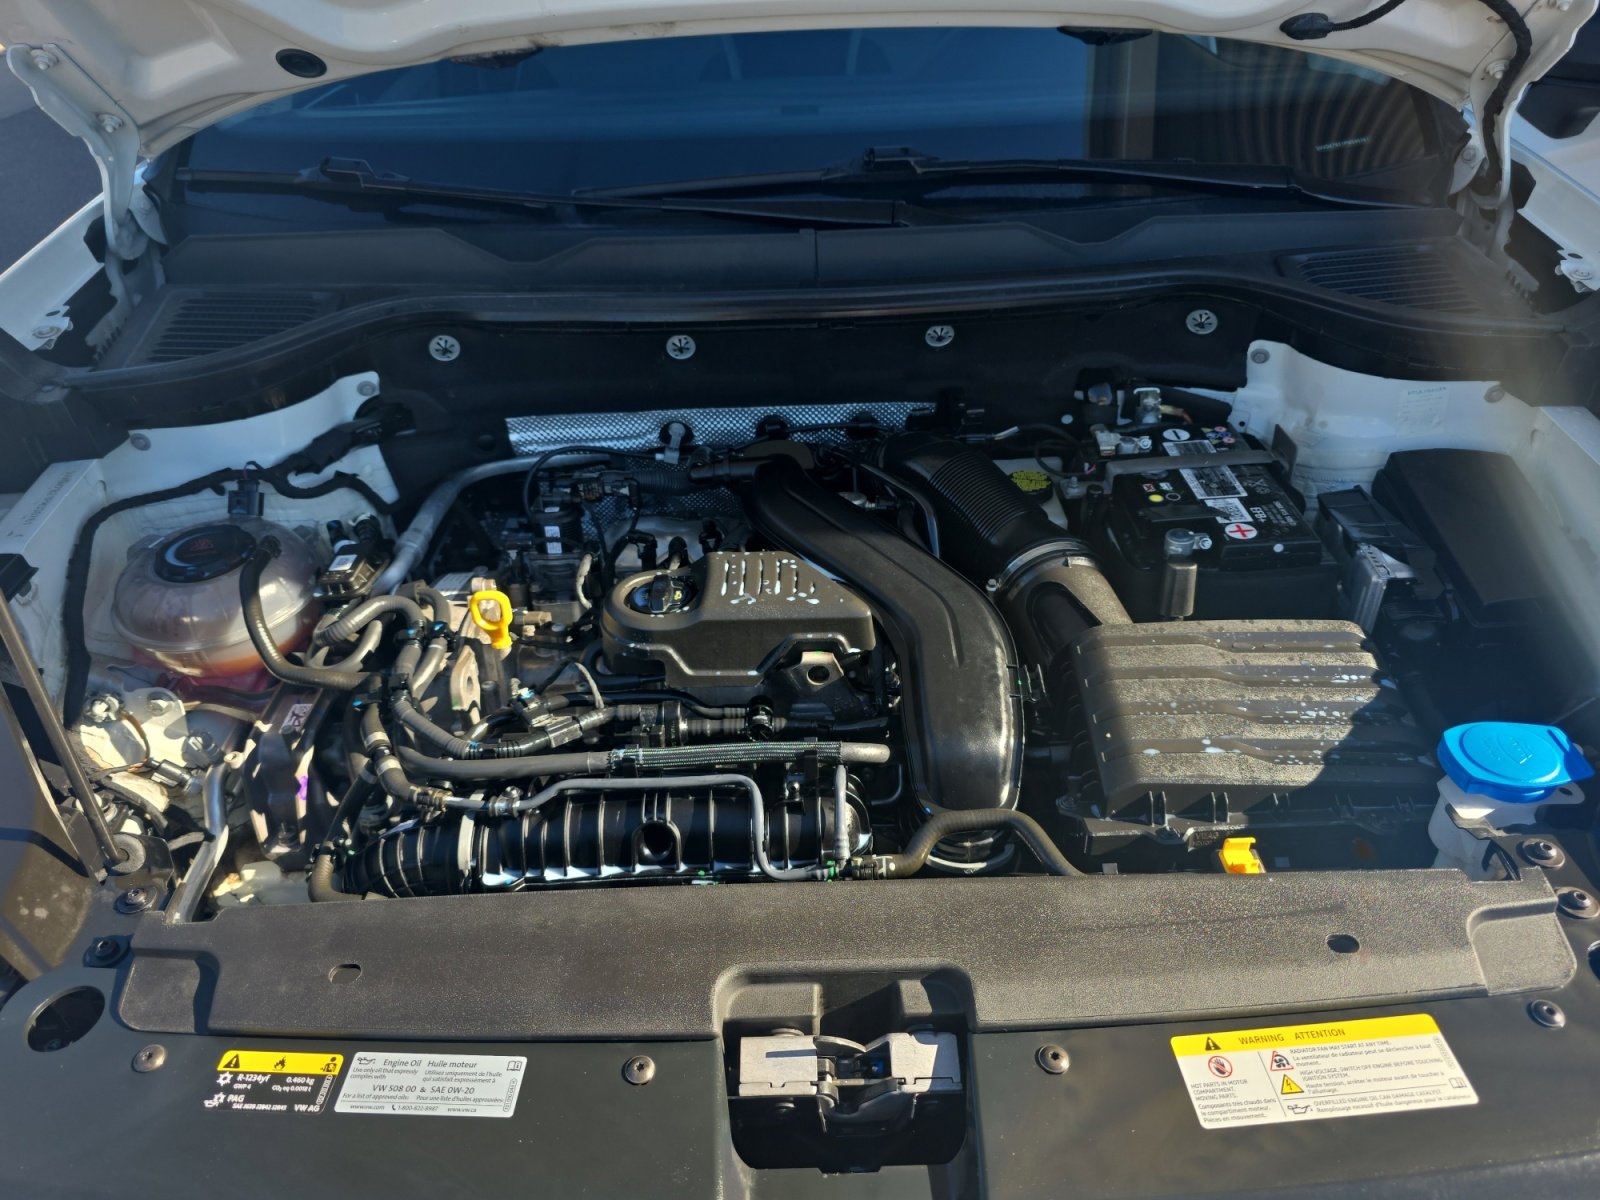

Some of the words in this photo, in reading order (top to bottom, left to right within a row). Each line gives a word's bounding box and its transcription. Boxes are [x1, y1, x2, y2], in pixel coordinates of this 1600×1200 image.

[1238, 1033, 1285, 1045] WARNING
[1294, 1028, 1346, 1040] ATTENTION
[384, 1059, 410, 1067] Engine
[237, 1074, 271, 1084] R-1234yf
[306, 1077, 316, 1086] kg
[227, 1094, 246, 1102] PAG
[1313, 1098, 1347, 1106] OVERFILLED
